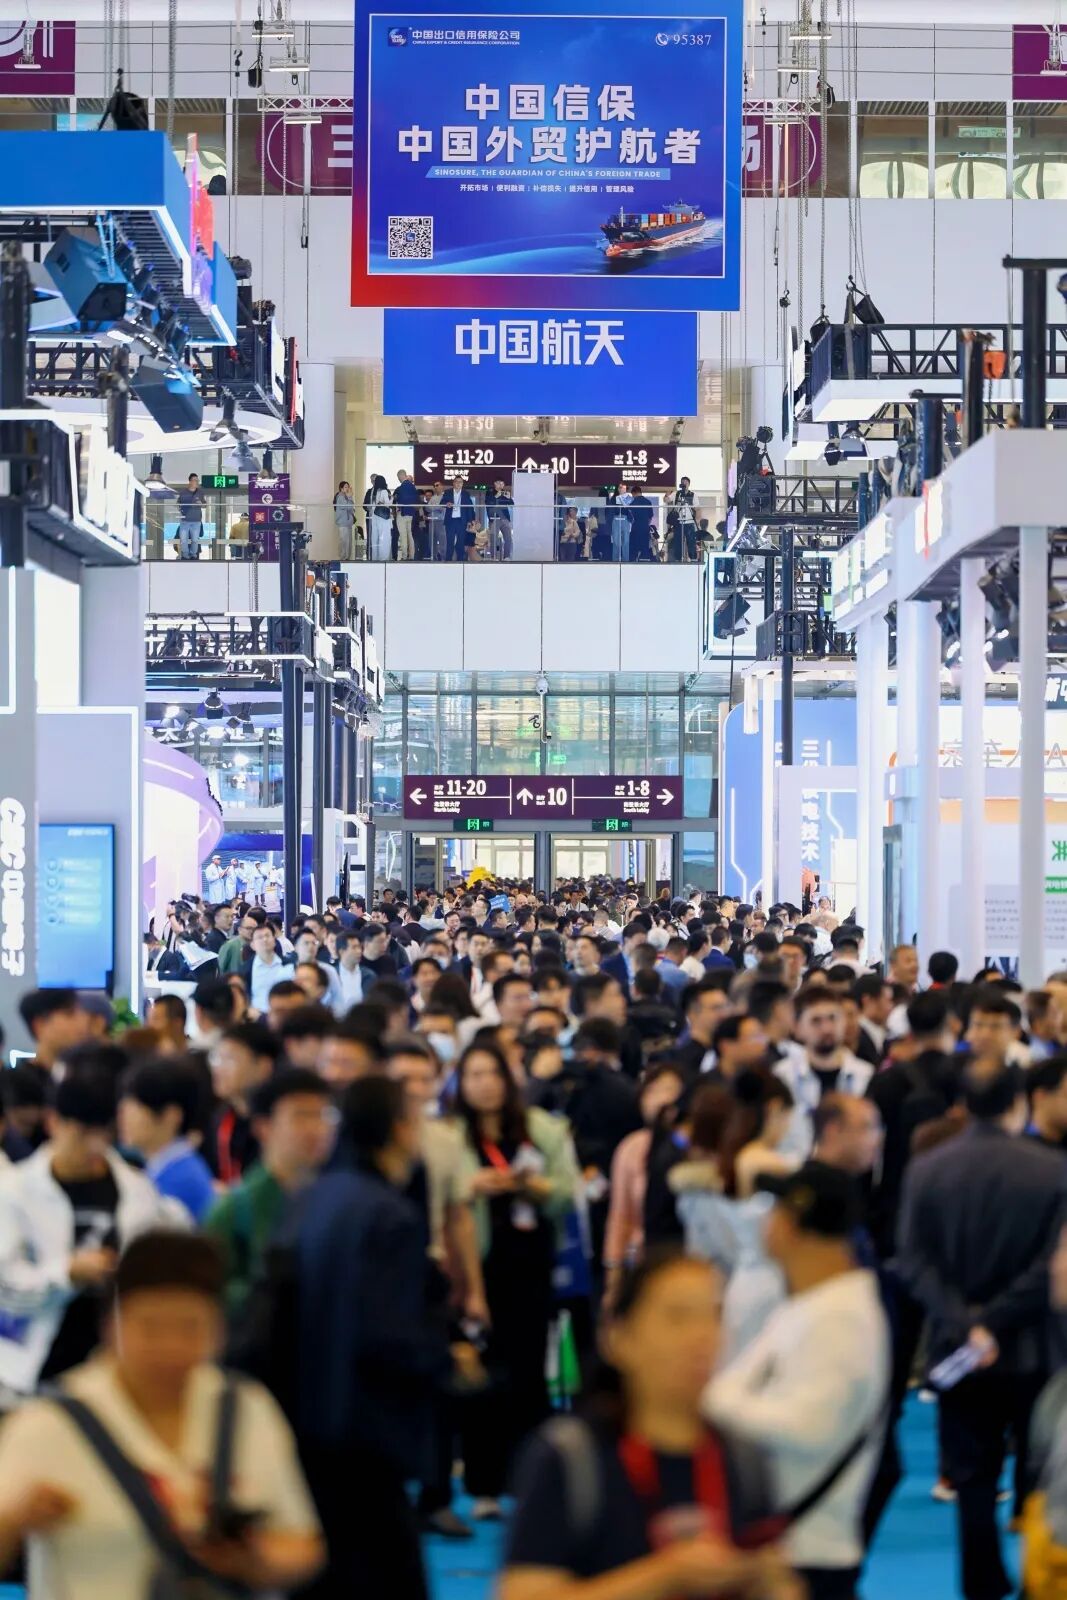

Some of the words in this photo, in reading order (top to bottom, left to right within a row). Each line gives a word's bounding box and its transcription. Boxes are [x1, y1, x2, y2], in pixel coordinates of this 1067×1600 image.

[412, 30, 520, 40] 中国出口信用保险公司
[673, 34, 712, 45] 95387
[465, 83, 636, 121] 中国信保
[398, 125, 701, 164] 中国外贸护航者
[434, 169, 478, 177] SINOSURE,
[460, 184, 488, 192] 开拓市场
[455, 319, 624, 365] 中国航天
[456, 449, 494, 464] 11-20
[626, 450, 647, 465] 1-8
[550, 457, 569, 474] 10
[447, 780, 486, 796] 11-20
[627, 780, 650, 796] 1-8
[547, 788, 567, 806] 10
